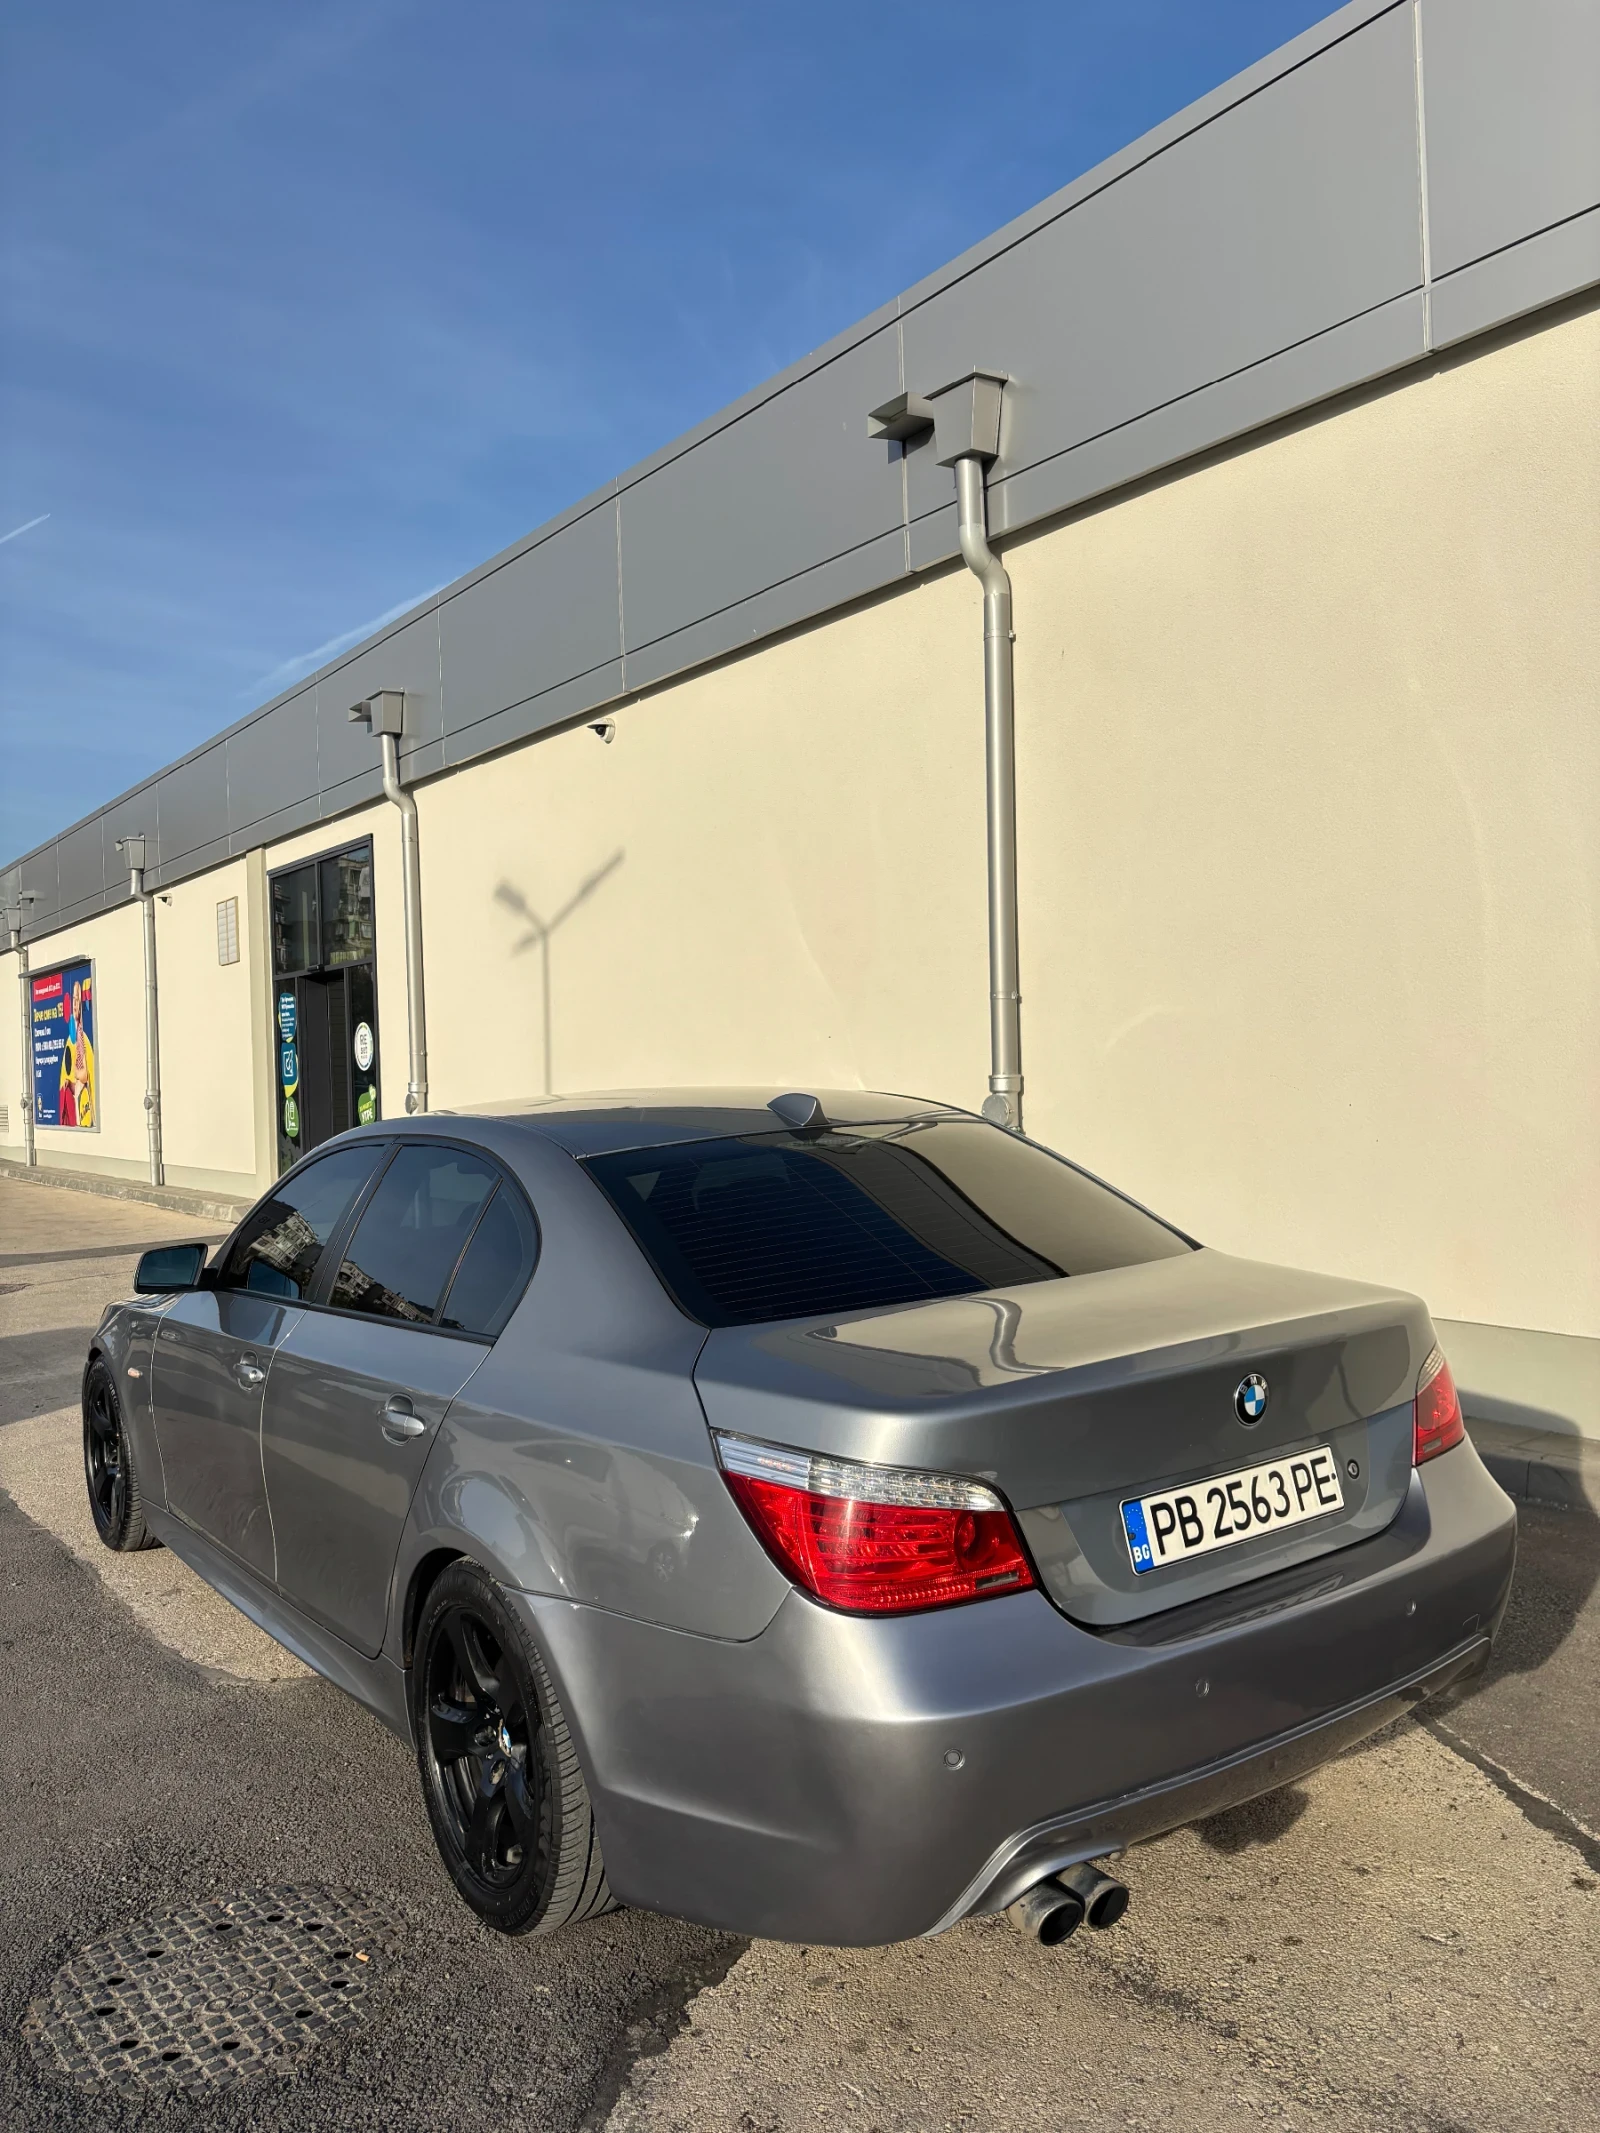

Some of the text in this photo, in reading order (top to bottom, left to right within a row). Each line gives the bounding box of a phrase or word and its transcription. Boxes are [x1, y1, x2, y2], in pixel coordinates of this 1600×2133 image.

[1240, 1375, 1267, 1395] BMW
[1150, 1455, 1337, 1556] PB 2563 PE
[1132, 1543, 1150, 1563] BG
